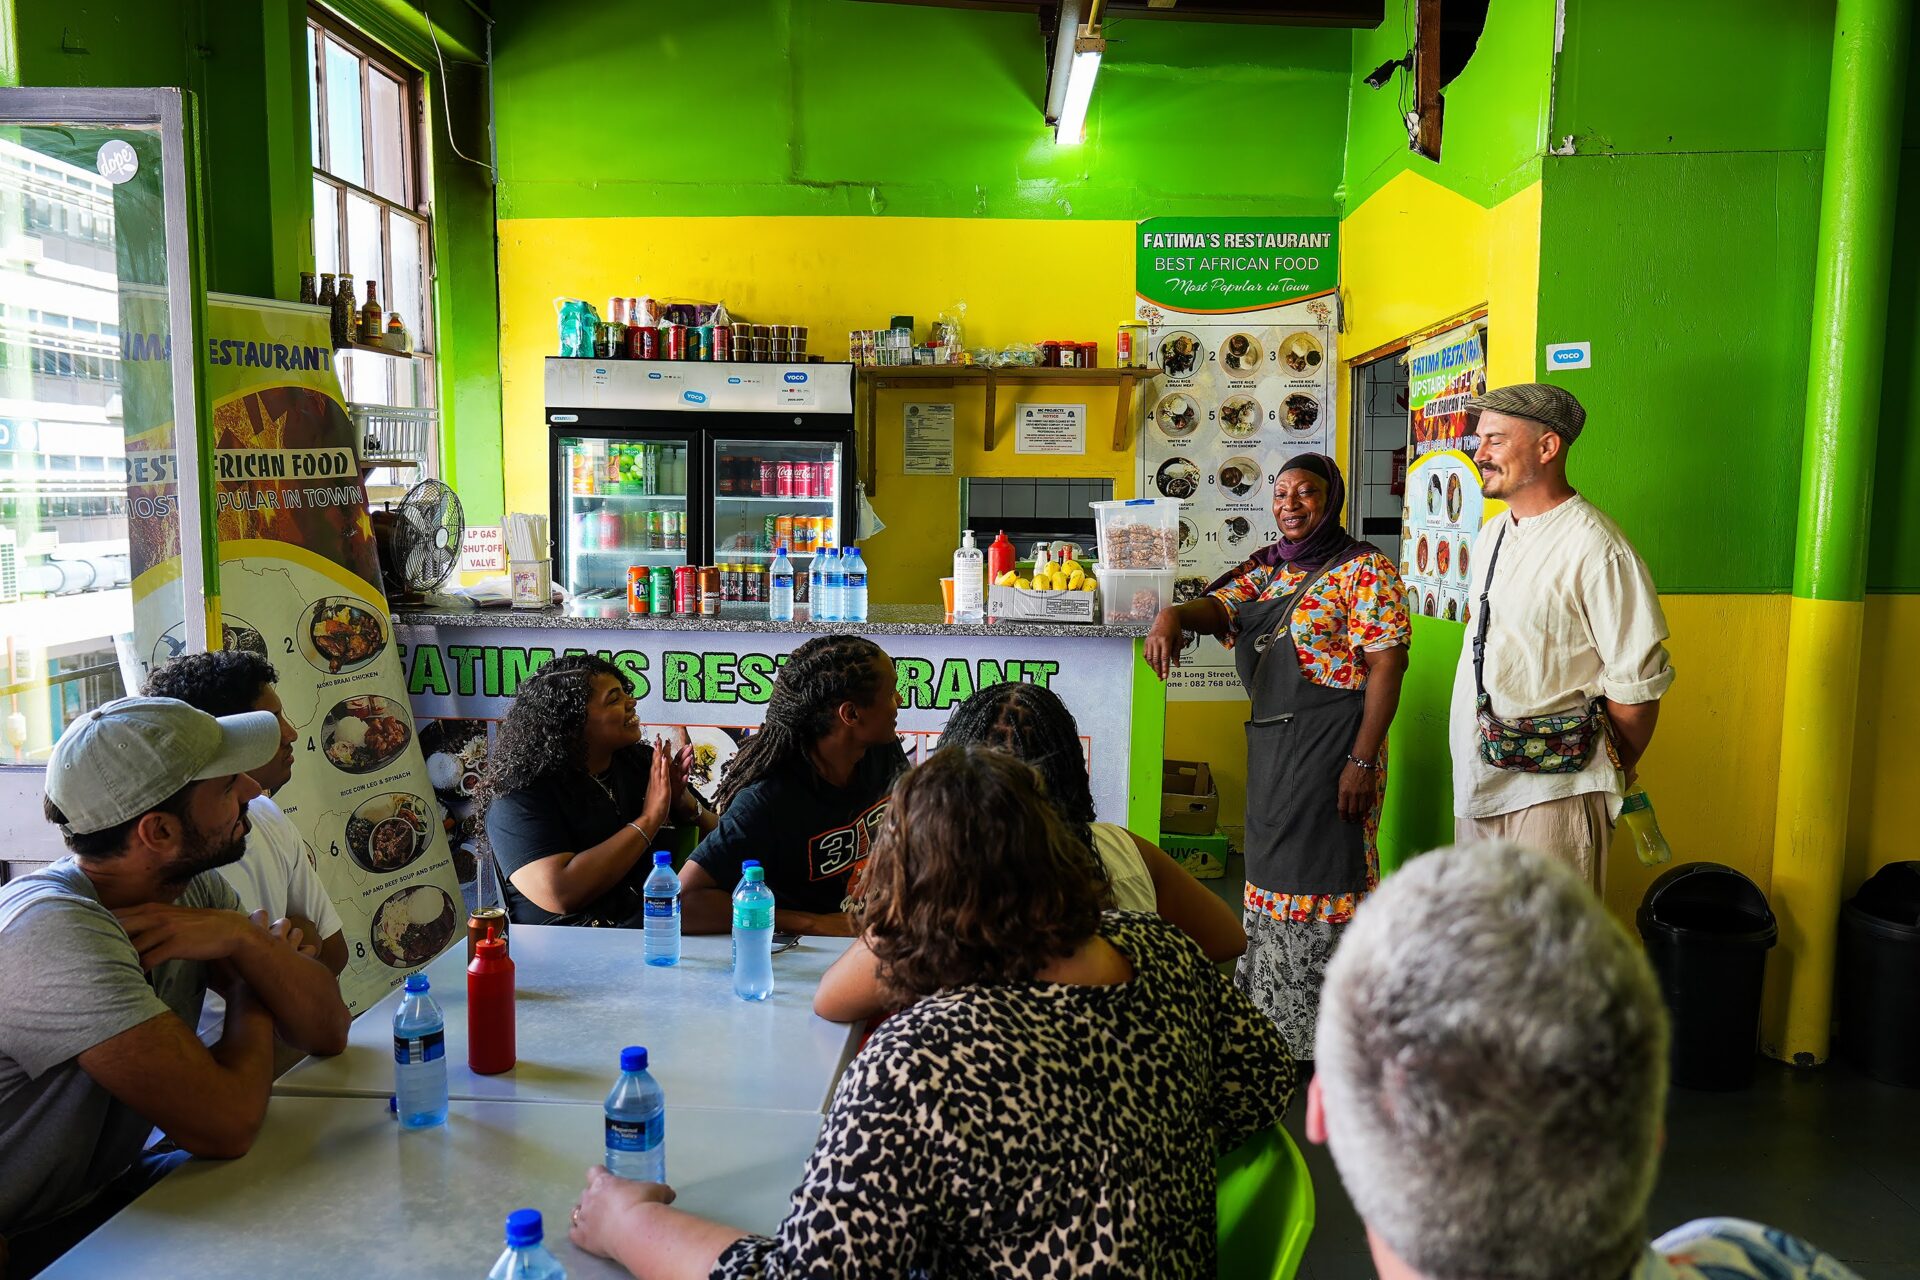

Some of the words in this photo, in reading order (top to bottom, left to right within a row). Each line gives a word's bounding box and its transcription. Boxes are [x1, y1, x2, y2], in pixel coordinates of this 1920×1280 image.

[1143, 232, 1221, 249] FATIMA'S
[1224, 232, 1331, 249] RESTAURANT
[1155, 257, 1196, 271] BEST
[1199, 257, 1270, 271] AFRICAN
[1275, 257, 1320, 271] FOOD
[1165, 277, 1208, 295] Most
[1210, 278, 1263, 296] Popular
[1266, 281, 1279, 292] in
[1276, 278, 1311, 293] Town
[209, 338, 330, 372] ESTAURANT
[1148, 352, 1154, 362] 1
[1209, 351, 1216, 361] 2
[1269, 351, 1277, 361] 3
[1412, 352, 1439, 377] FATIMA
[1412, 374, 1446, 398] UPSTAIRS
[1147, 411, 1155, 421] 4
[1208, 411, 1215, 420] 5
[1268, 410, 1276, 420] 6
[293, 450, 348, 477] FOOD
[1147, 475, 1154, 485] 7
[1208, 474, 1215, 485] 8
[1268, 474, 1275, 485] 9
[281, 489, 302, 508] IN
[303, 485, 364, 506] TOWN
[467, 530, 478, 539] LP
[480, 530, 497, 539] GAS
[1205, 532, 1217, 542] 11
[1263, 531, 1277, 542] 12
[462, 544, 503, 553] SHUT-OFF
[470, 558, 496, 567] VALVE
[283, 637, 295, 654] 2
[351, 671, 379, 682] CHICKEN
[1184, 671, 1205, 679] Long
[306, 736, 316, 753] 4
[340, 788, 352, 797] RICE
[353, 784, 366, 793] COW
[384, 770, 411, 783] SPINACH
[283, 805, 298, 815] FISH
[330, 840, 339, 857] 6
[362, 889, 373, 898] PAP
[372, 885, 384, 894] AND
[385, 878, 399, 888] BEEF
[399, 872, 415, 883] SOUP
[415, 867, 429, 877] AND
[355, 941, 366, 959] 8
